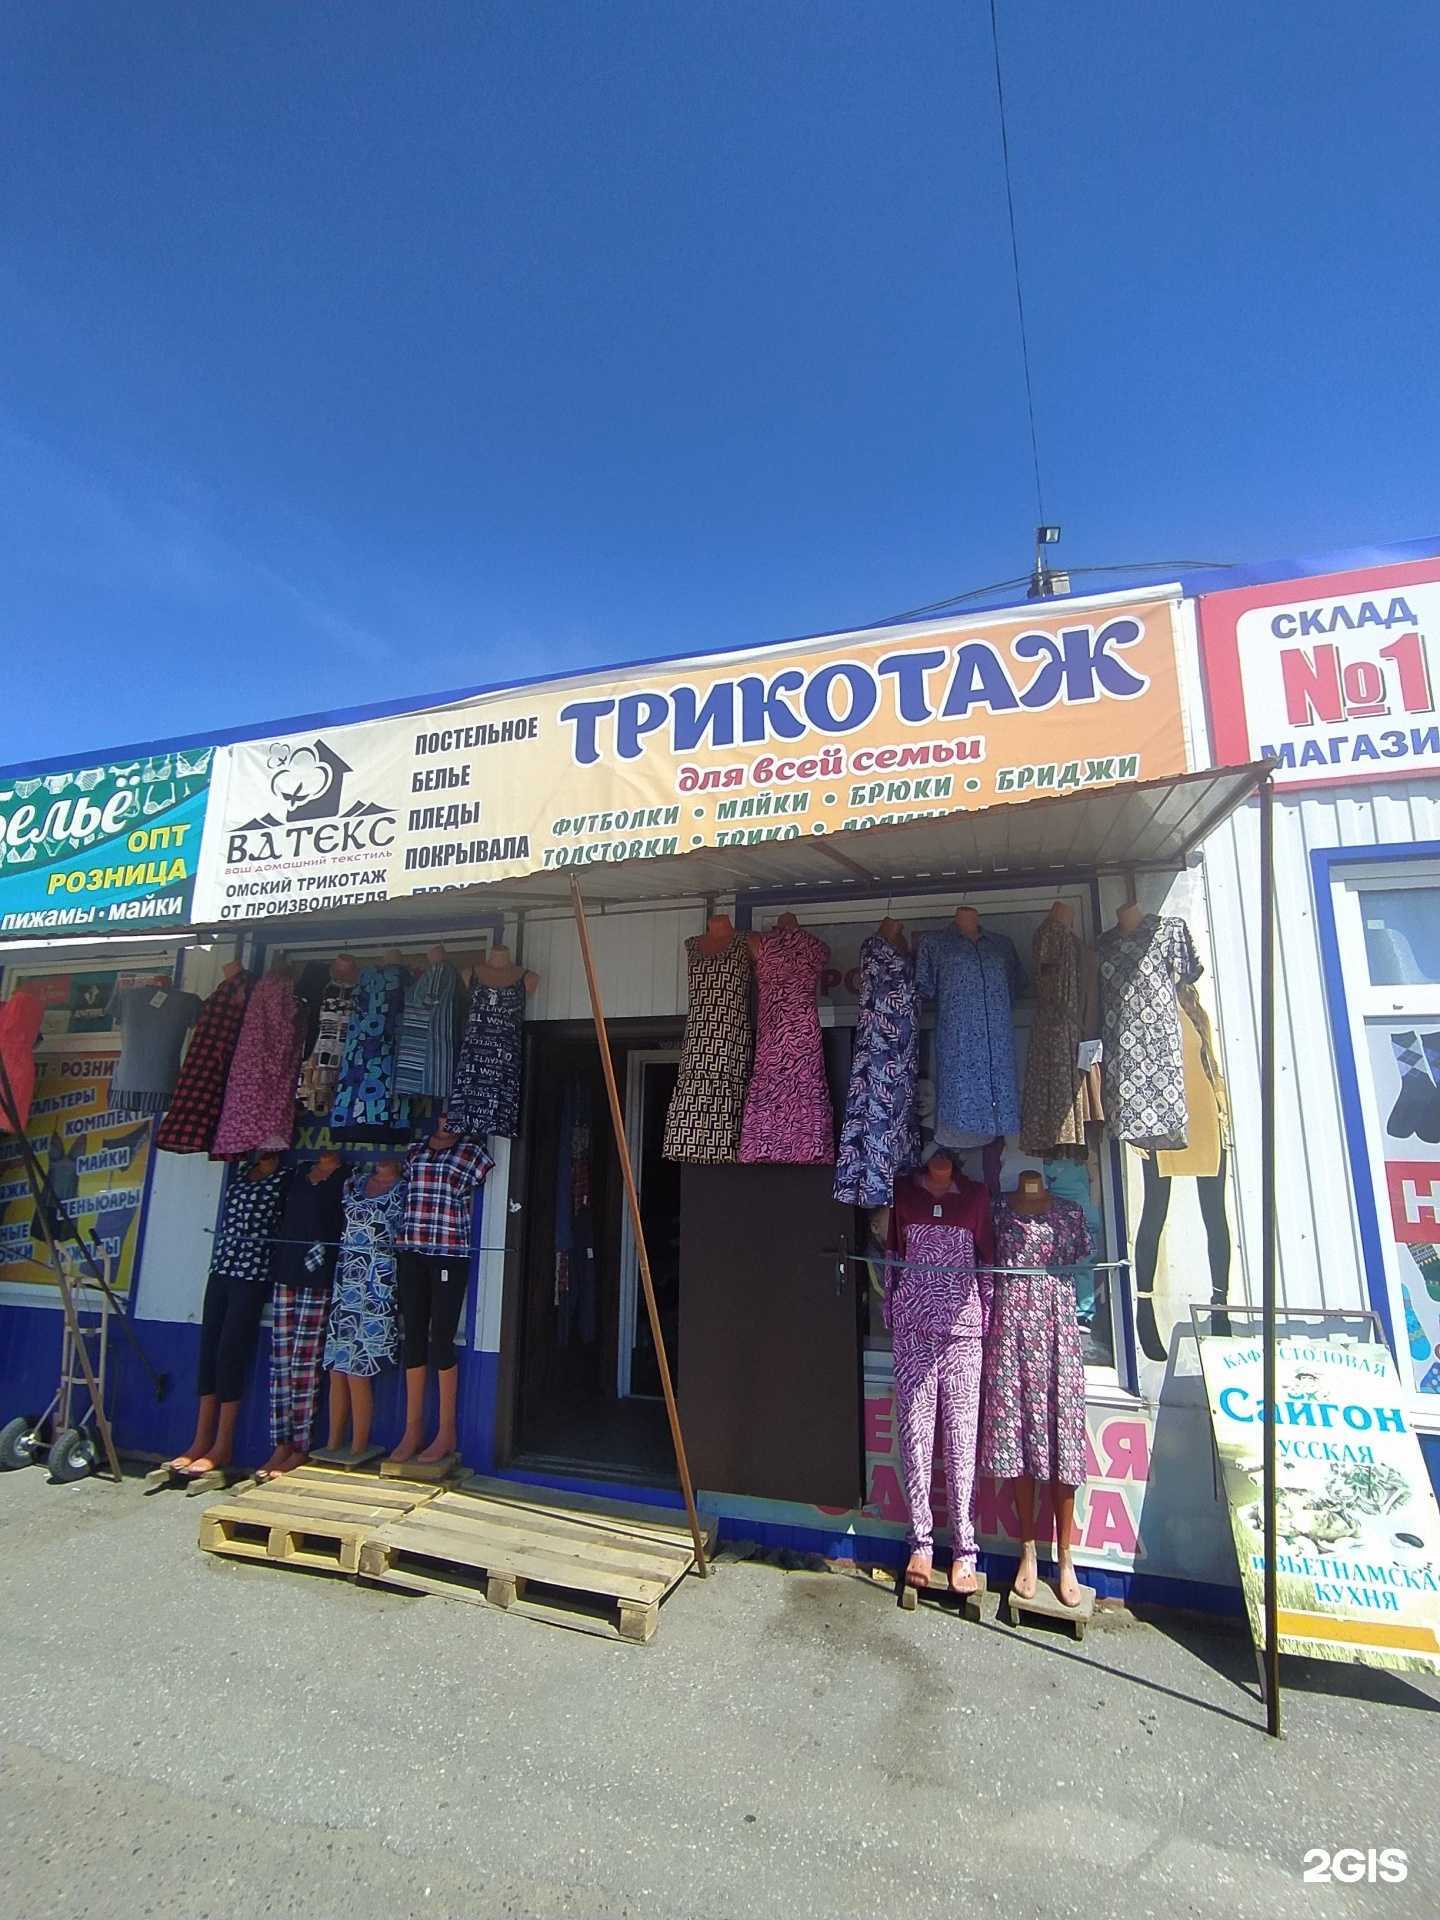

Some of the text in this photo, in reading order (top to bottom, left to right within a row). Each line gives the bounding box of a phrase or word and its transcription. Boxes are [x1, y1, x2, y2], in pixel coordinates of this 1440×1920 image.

[1271, 597, 1418, 638] СКЛАД
[561, 620, 1145, 764] ТРИКОТАЖ
[1280, 632, 1434, 727] №1
[415, 717, 538, 755] ПОСТЕЛЬНОЕ
[412, 765, 471, 793] БЕЛЬЕ
[679, 740, 981, 792] для всей семьи
[552, 756, 1137, 836] ФУТБОЛКИ МАЙКИ БРЮКИ БРИДЖИ
[408, 802, 480, 831] ПЛЕДЫ
[128, 824, 191, 853] ОПТ
[405, 835, 529, 870] ПОКРЫВАЛА
[544, 837, 677, 867] ТОЛСТОВКИ
[47, 858, 188, 895] РОЗНИЦА
[226, 876, 292, 898] ОМСКИЙ
[297, 869, 387, 891] ТРИКОТАЖ
[221, 891, 387, 919] ОТ ПРОИЗВОДИТЕЛЯ
[61, 1060, 119, 1077] РОЗНИ
[79, 1148, 129, 1173] МАЙКИ
[1223, 1349, 1263, 1370] КАФ
[1278, 1439, 1375, 1464] УССКАЯ
[1276, 1554, 1440, 1592] ВЬЕТНАМСКА
[1315, 1582, 1398, 1611] КУХНЯ
